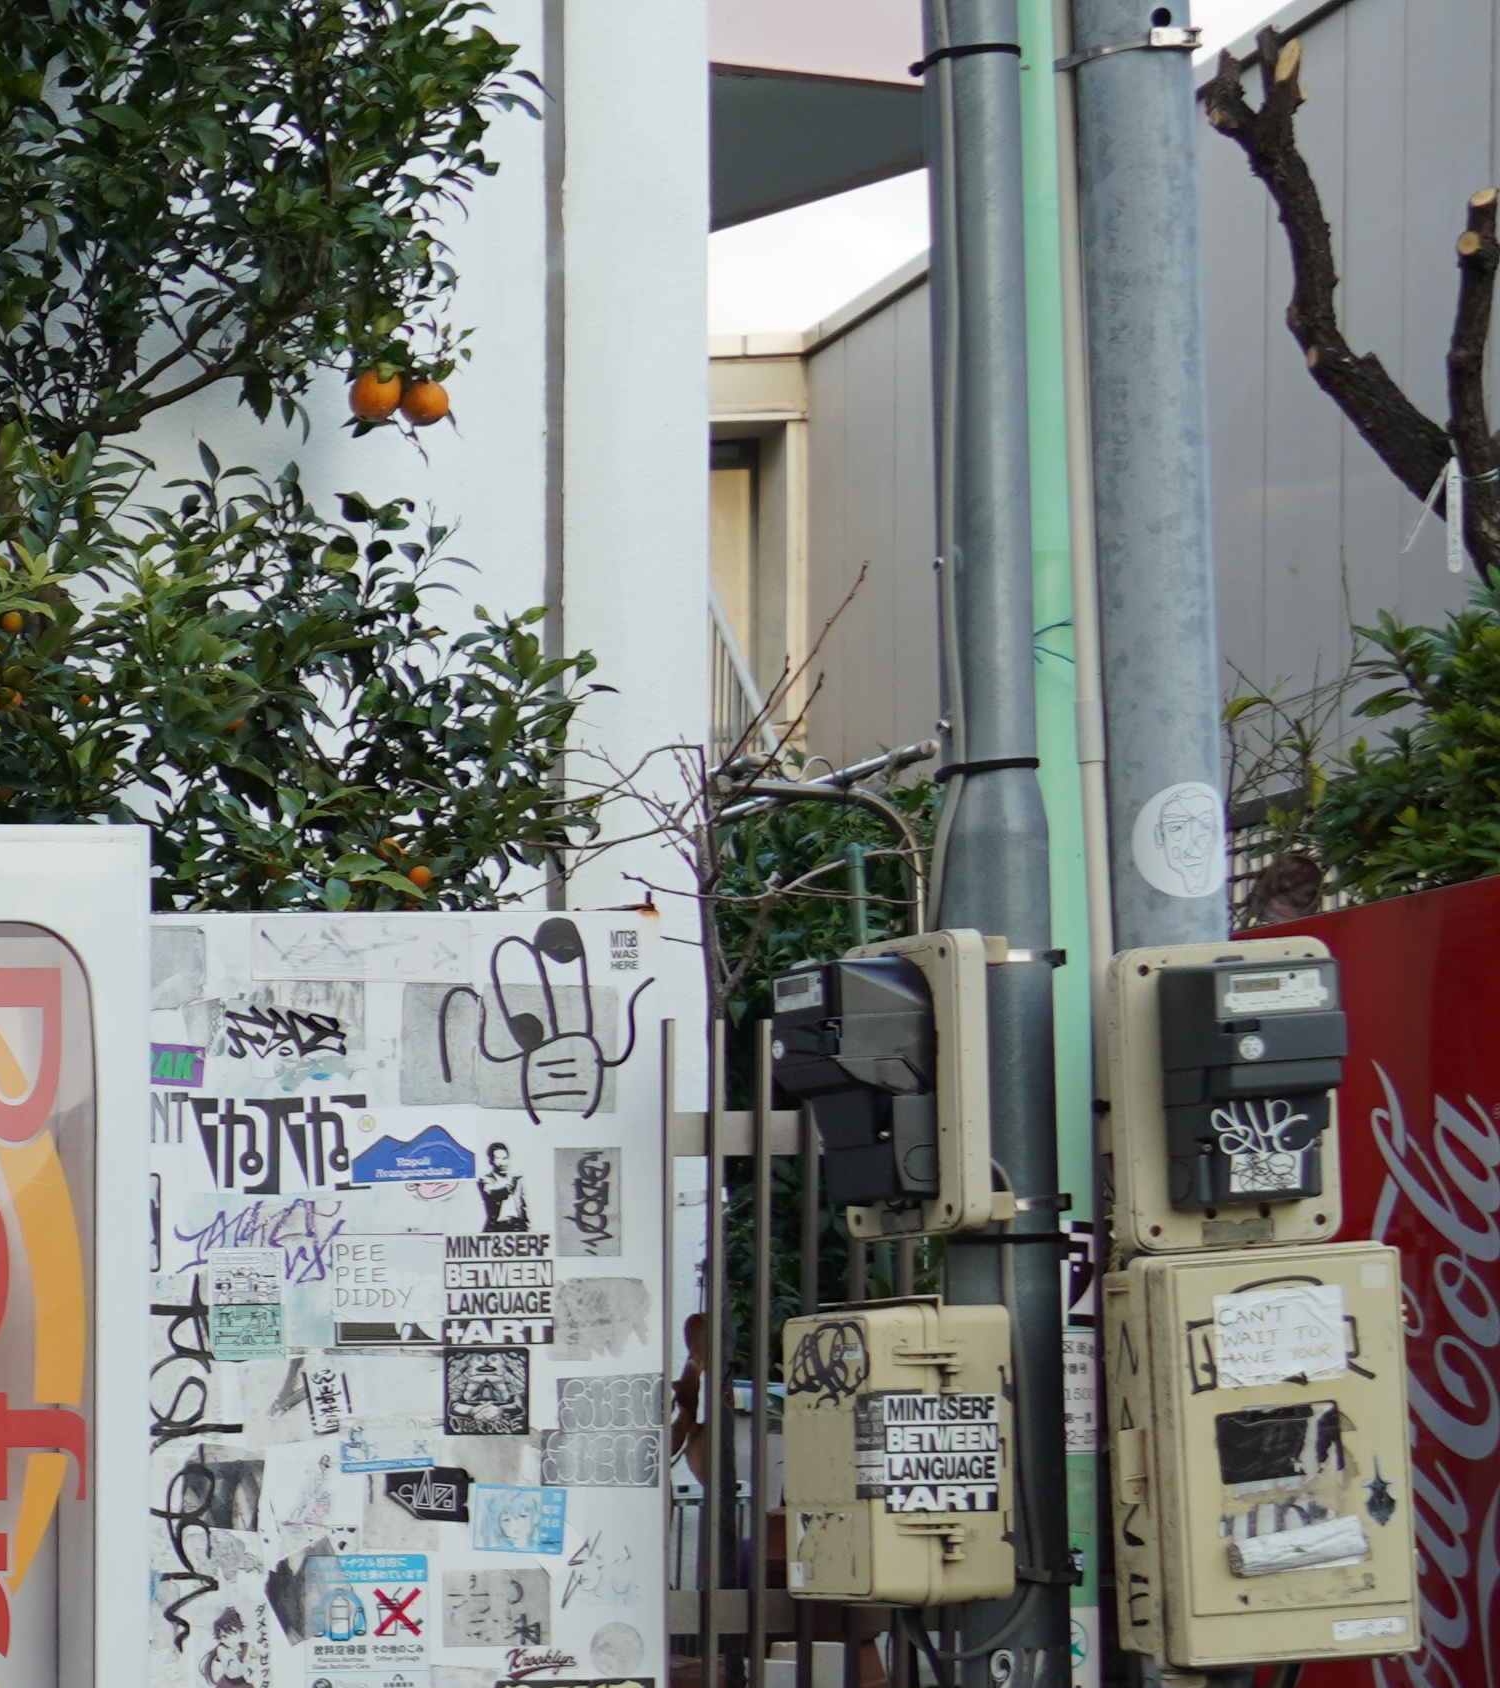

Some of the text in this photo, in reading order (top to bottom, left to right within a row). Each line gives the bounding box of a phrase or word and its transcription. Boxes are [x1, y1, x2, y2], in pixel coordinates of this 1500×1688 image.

[610, 950, 639, 959] WAS
[610, 961, 639, 970] HERE
[334, 1243, 384, 1262] PEE
[446, 1234, 550, 1259] MINT&SERF
[448, 1263, 551, 1288] BETWEEN
[334, 1287, 413, 1308] DIDDY
[446, 1292, 551, 1315] LANGUAGE
[1217, 1305, 1286, 1327] CAN'T
[1215, 1325, 1322, 1348] WAIT TO
[1215, 1342, 1332, 1366] HAVE YOUR
[887, 1397, 996, 1422] MINT&SERF
[886, 1425, 997, 1451] BETWEEN
[887, 1457, 996, 1482] LANGUAGE
